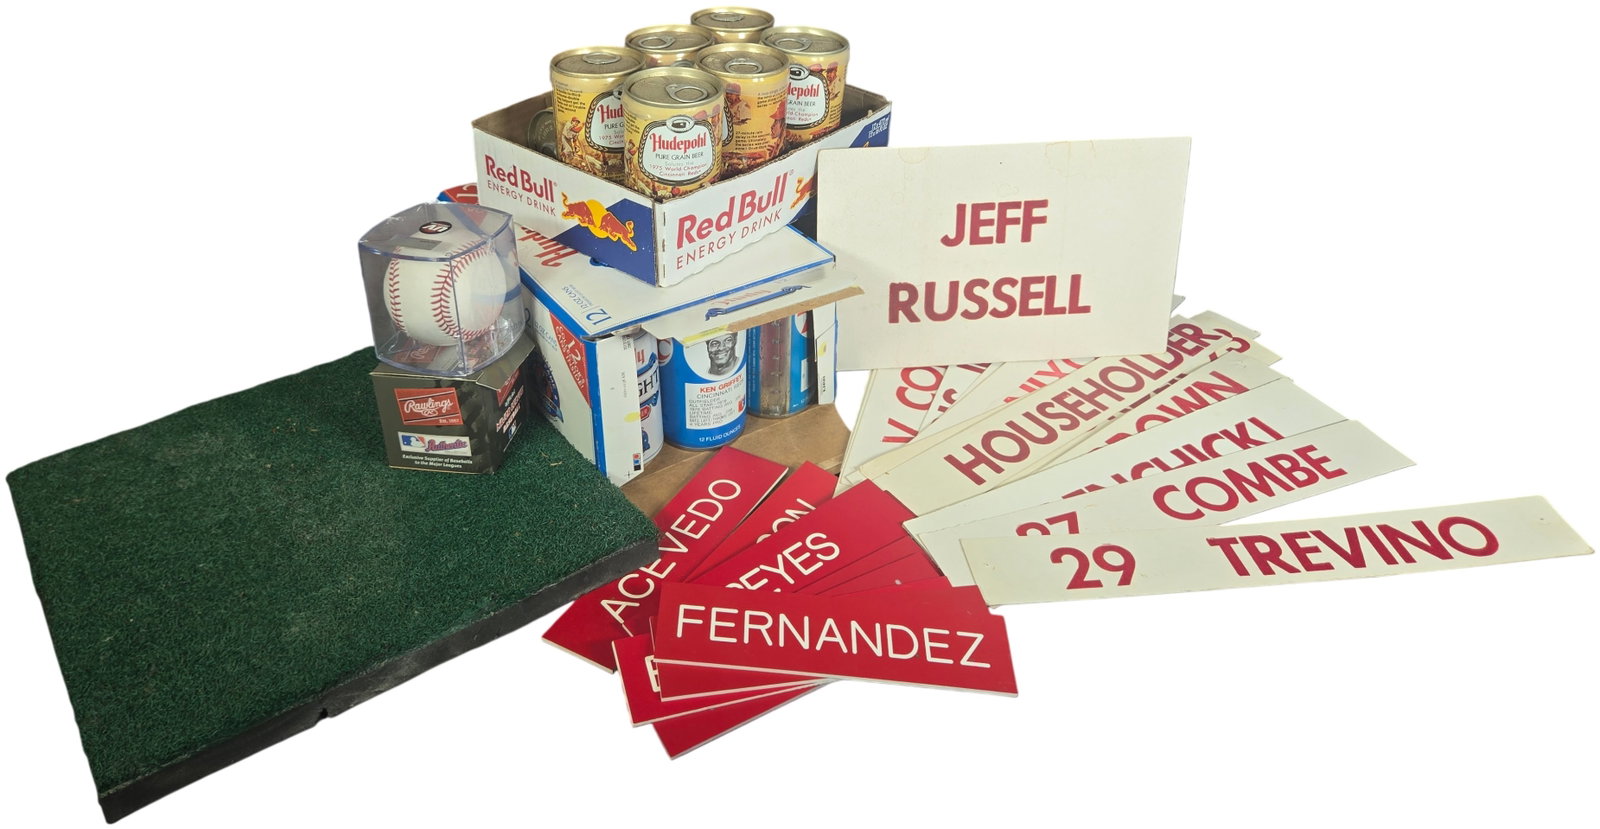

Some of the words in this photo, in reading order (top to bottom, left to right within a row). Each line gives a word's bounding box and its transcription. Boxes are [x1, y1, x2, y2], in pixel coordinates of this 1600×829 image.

[649, 132, 707, 154] Hudepohl
[655, 152, 670, 160] PURE
[671, 153, 690, 161] GRAIN
[692, 151, 704, 159] BEER
[485, 154, 519, 188] Red
[520, 169, 555, 203] Bull
[487, 180, 523, 202] ENERGY
[526, 196, 556, 217] DRINK
[676, 195, 736, 250] Red
[737, 171, 789, 224] Bull
[940, 199, 1049, 247] JEFF
[676, 231, 737, 270] ENERGY
[740, 208, 782, 239] DRINK
[888, 274, 1092, 324] RUSSELL
[696, 387, 733, 400] CINCINNATI
[700, 385, 717, 394] KEN
[718, 373, 743, 391] GRIFFEY
[943, 323, 1223, 486] HOUSEHOLDER
[404, 397, 454, 414] Rawlings
[425, 438, 469, 453] Authentic
[706, 434, 723, 442] FLUID
[723, 424, 741, 438] OUNCES
[424, 455, 444, 463] Supplier
[450, 457, 473, 465] Baseballs
[429, 460, 443, 468] Major
[443, 461, 463, 469] Leagues
[1152, 443, 1348, 521] COMBE
[600, 478, 742, 624] ACEVEDO
[1049, 544, 1137, 590] 29
[1206, 515, 1500, 579] TREVINO
[676, 603, 992, 670] FERNANDEZ
